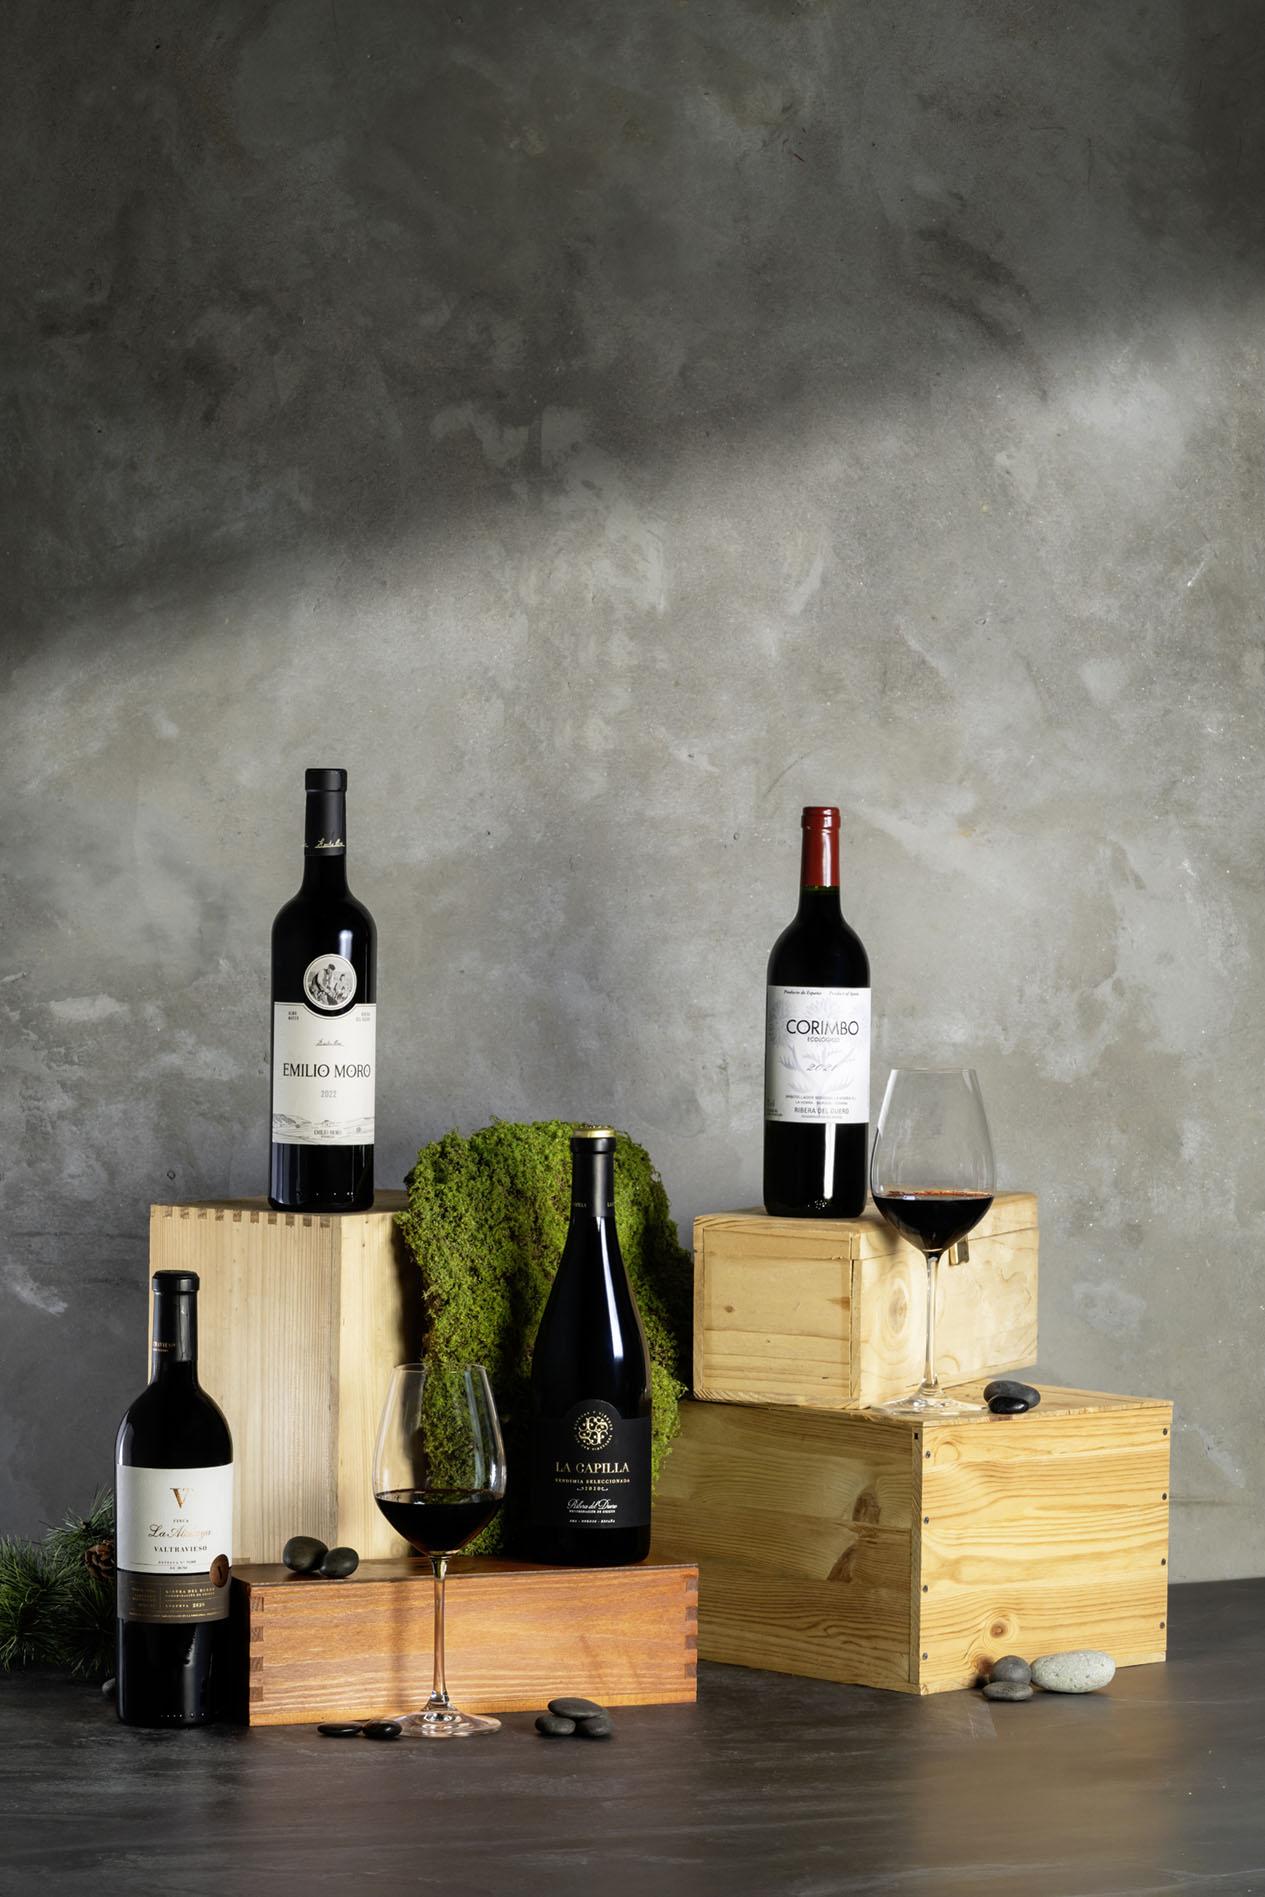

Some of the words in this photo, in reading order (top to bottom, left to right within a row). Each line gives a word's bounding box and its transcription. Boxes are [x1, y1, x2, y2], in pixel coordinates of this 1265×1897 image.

[786, 1019, 859, 1035] CORIMBO
[283, 1063, 330, 1078] EMILIO
[334, 1064, 371, 1078] MORO
[806, 1063, 839, 1072] 2021
[320, 1090, 337, 1098] 2022
[556, 1461, 571, 1472] LA
[575, 1461, 630, 1473] CAPILLA
[169, 1488, 193, 1508] V
[597, 1498, 618, 1510] Duero
[147, 1524, 166, 1537] La
